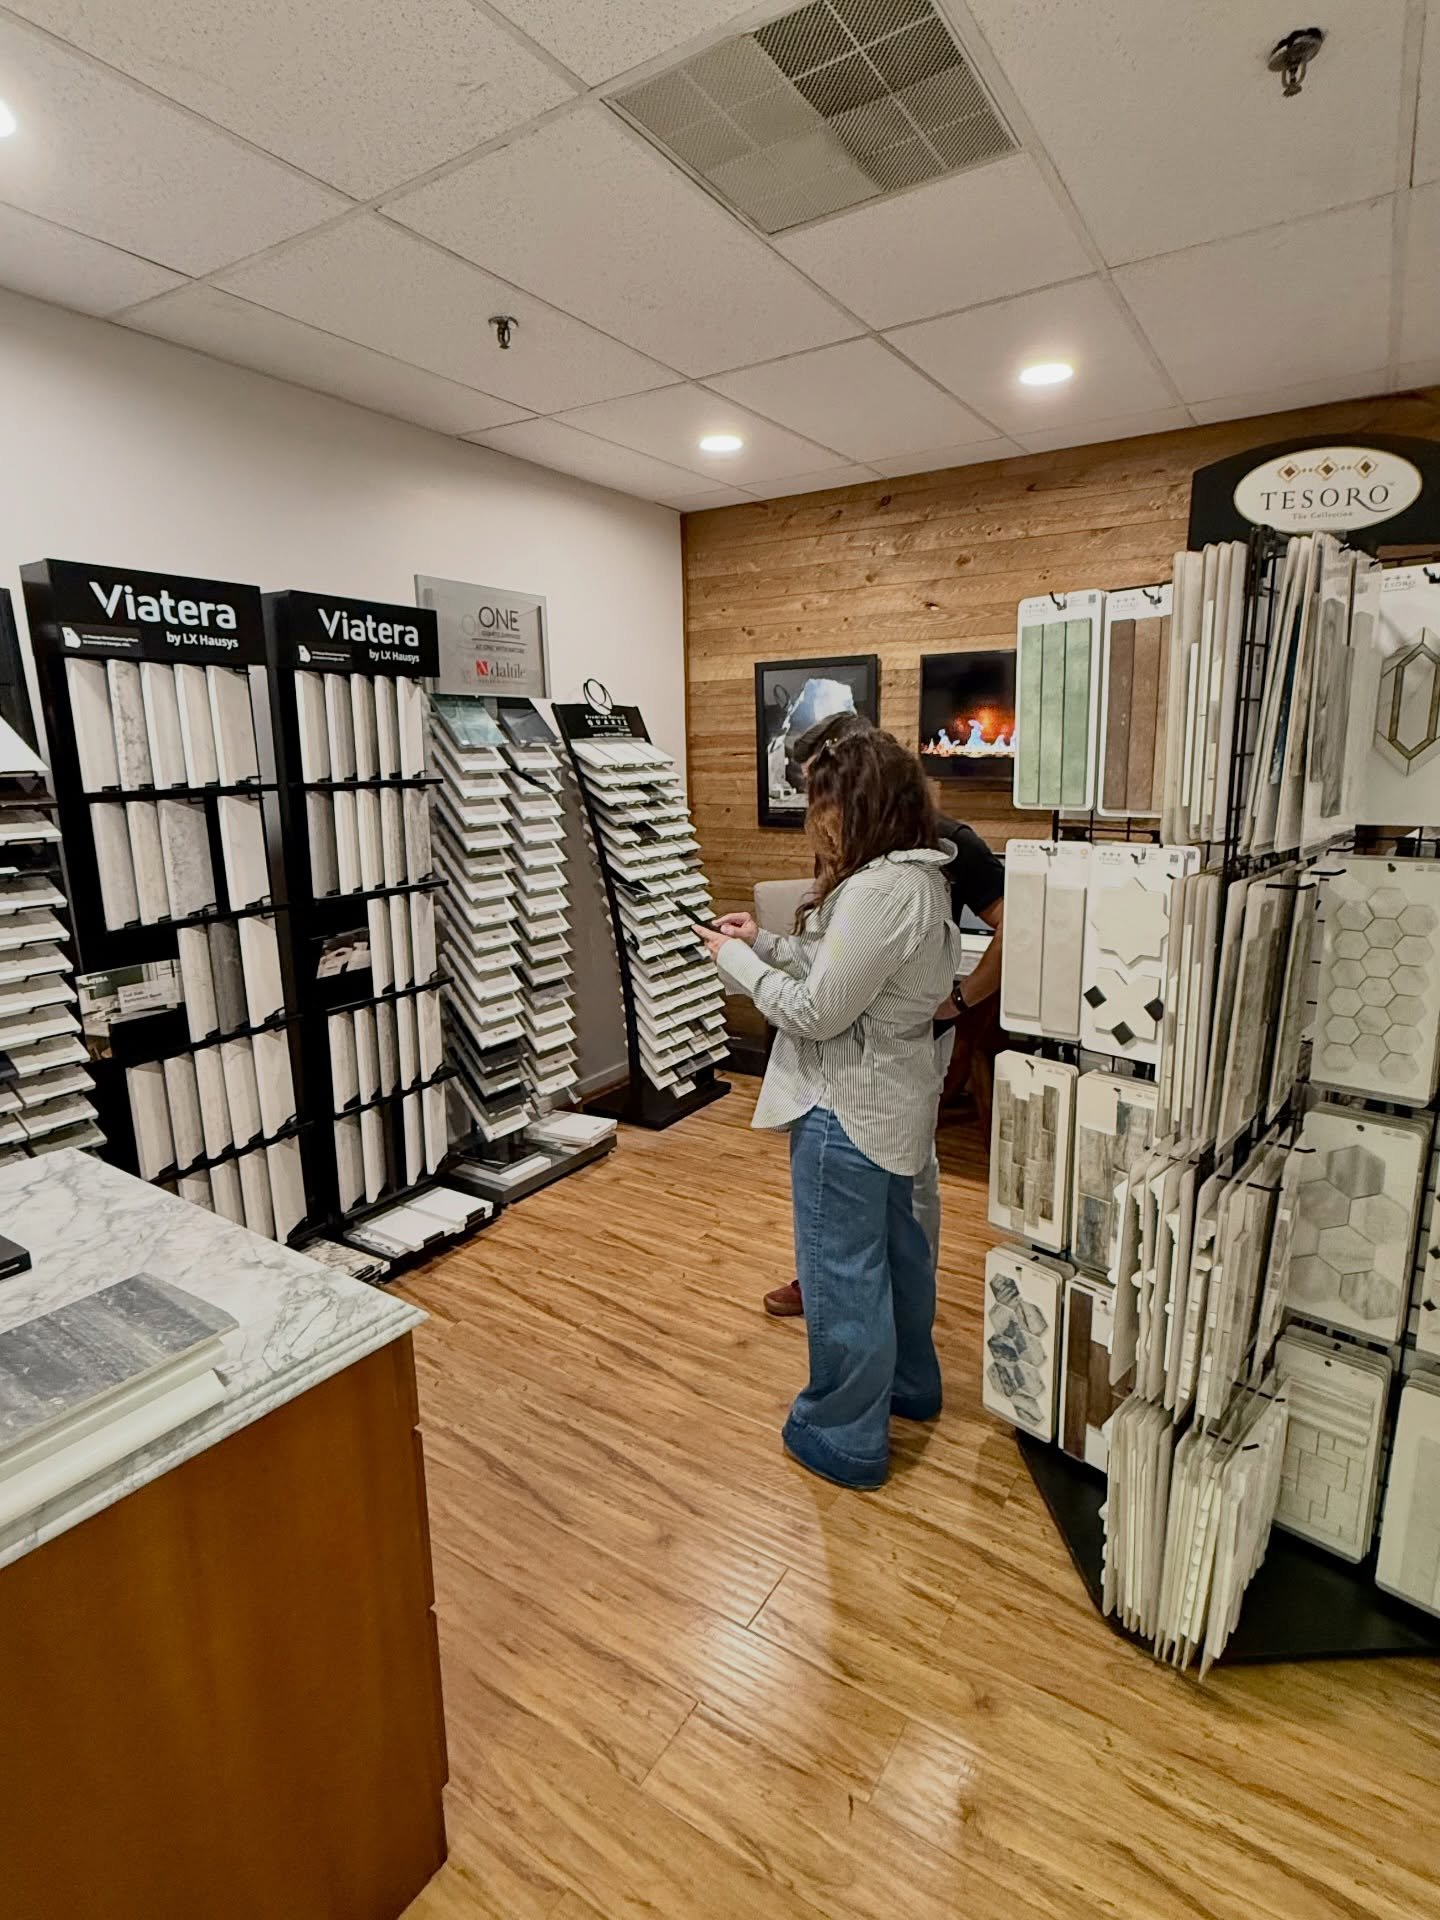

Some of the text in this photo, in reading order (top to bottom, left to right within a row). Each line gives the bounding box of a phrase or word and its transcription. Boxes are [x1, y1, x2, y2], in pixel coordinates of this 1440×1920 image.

[1260, 484, 1393, 513] TESORO
[88, 581, 237, 630] Viatera
[317, 608, 419, 647] Viatera
[478, 606, 520, 632] ONE
[165, 631, 239, 650] by LX Hausys
[368, 649, 420, 664] by LX Hausys
[490, 661, 525, 679] daltile
